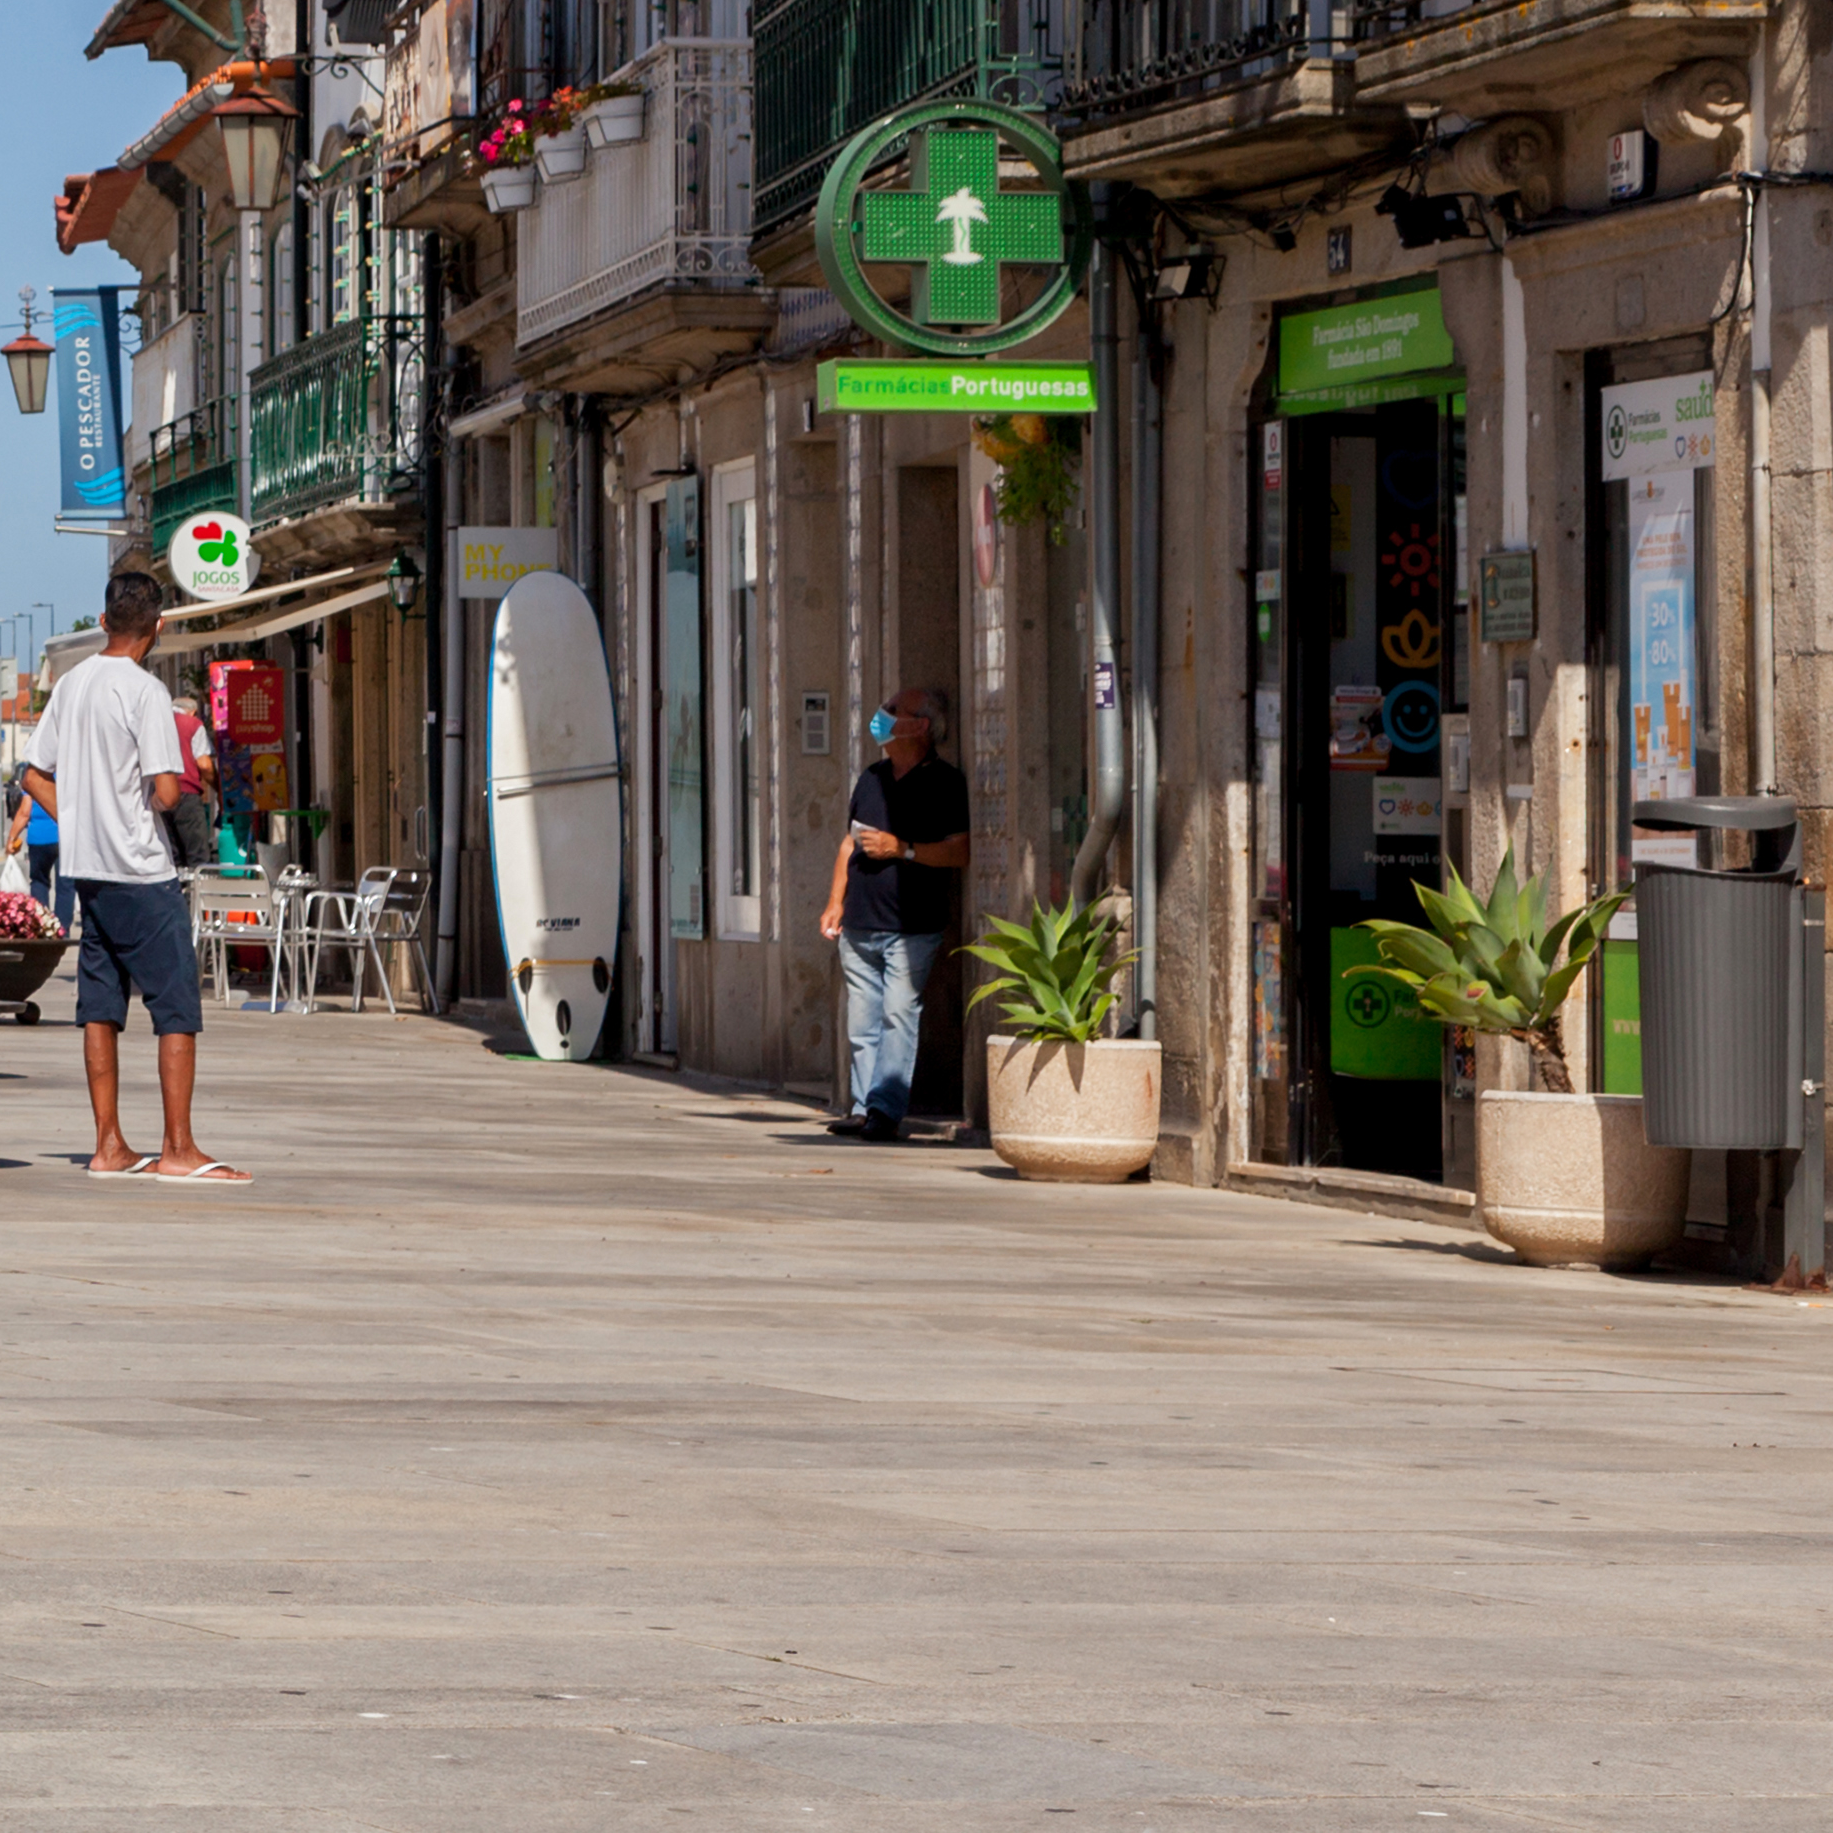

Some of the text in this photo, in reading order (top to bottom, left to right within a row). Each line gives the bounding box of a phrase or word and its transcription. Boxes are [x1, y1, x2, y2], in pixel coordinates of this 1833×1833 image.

[1329, 232, 1345, 268] 54
[1312, 311, 1420, 346] Farmácia São Domingos
[1366, 346, 1380, 363] em
[75, 336, 95, 470] O PESCADOR
[92, 374, 103, 448] RESTAURANTE
[465, 544, 505, 561] MY
[192, 571, 240, 589] JOGOS
[236, 723, 275, 734] payshop
[1399, 852, 1429, 867] aqui
